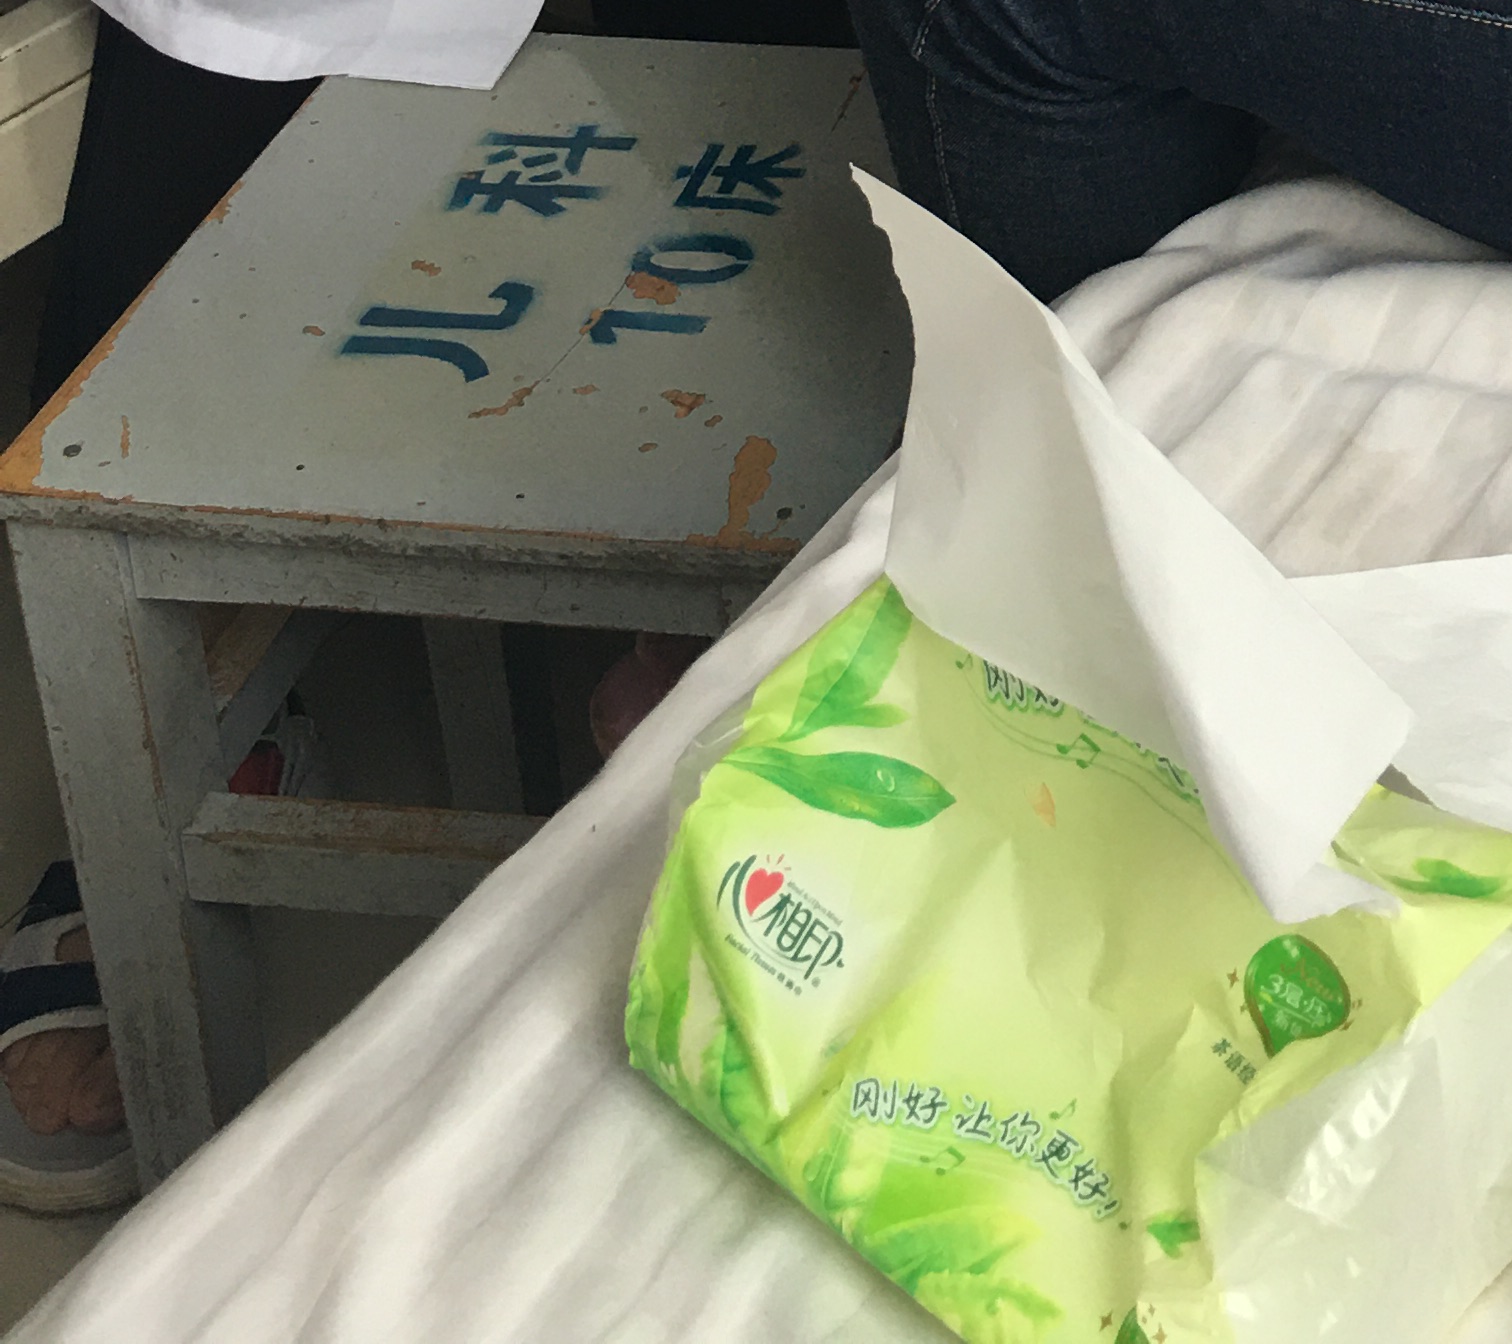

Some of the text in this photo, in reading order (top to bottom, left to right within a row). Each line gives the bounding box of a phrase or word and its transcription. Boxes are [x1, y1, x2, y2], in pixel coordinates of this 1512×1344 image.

[340, 124, 638, 383] 儿科
[717, 854, 845, 980] 心相印
